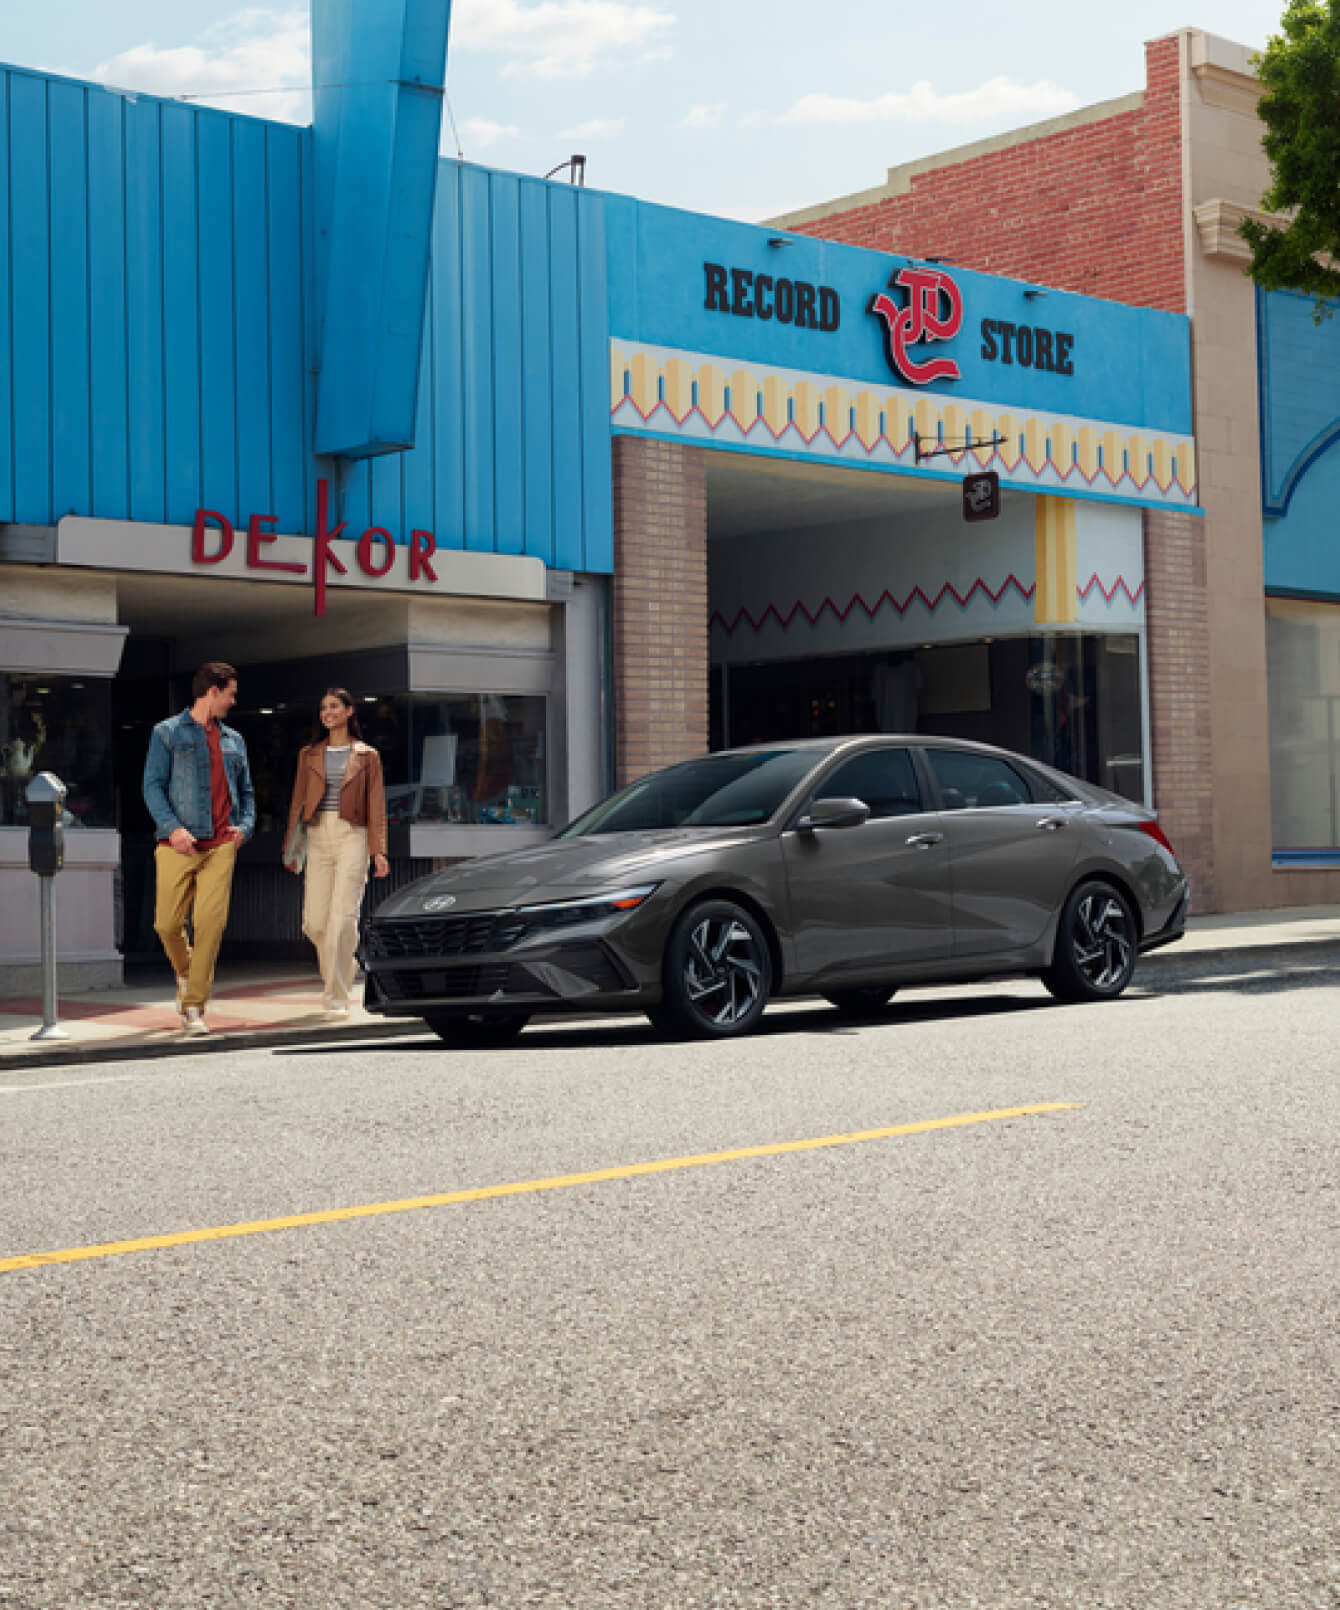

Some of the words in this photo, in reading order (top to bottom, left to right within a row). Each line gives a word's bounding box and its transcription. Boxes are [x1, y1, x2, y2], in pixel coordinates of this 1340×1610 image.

[704, 262, 841, 332] RECORD
[981, 318, 1074, 375] STORE
[192, 479, 438, 616] DEKOR
